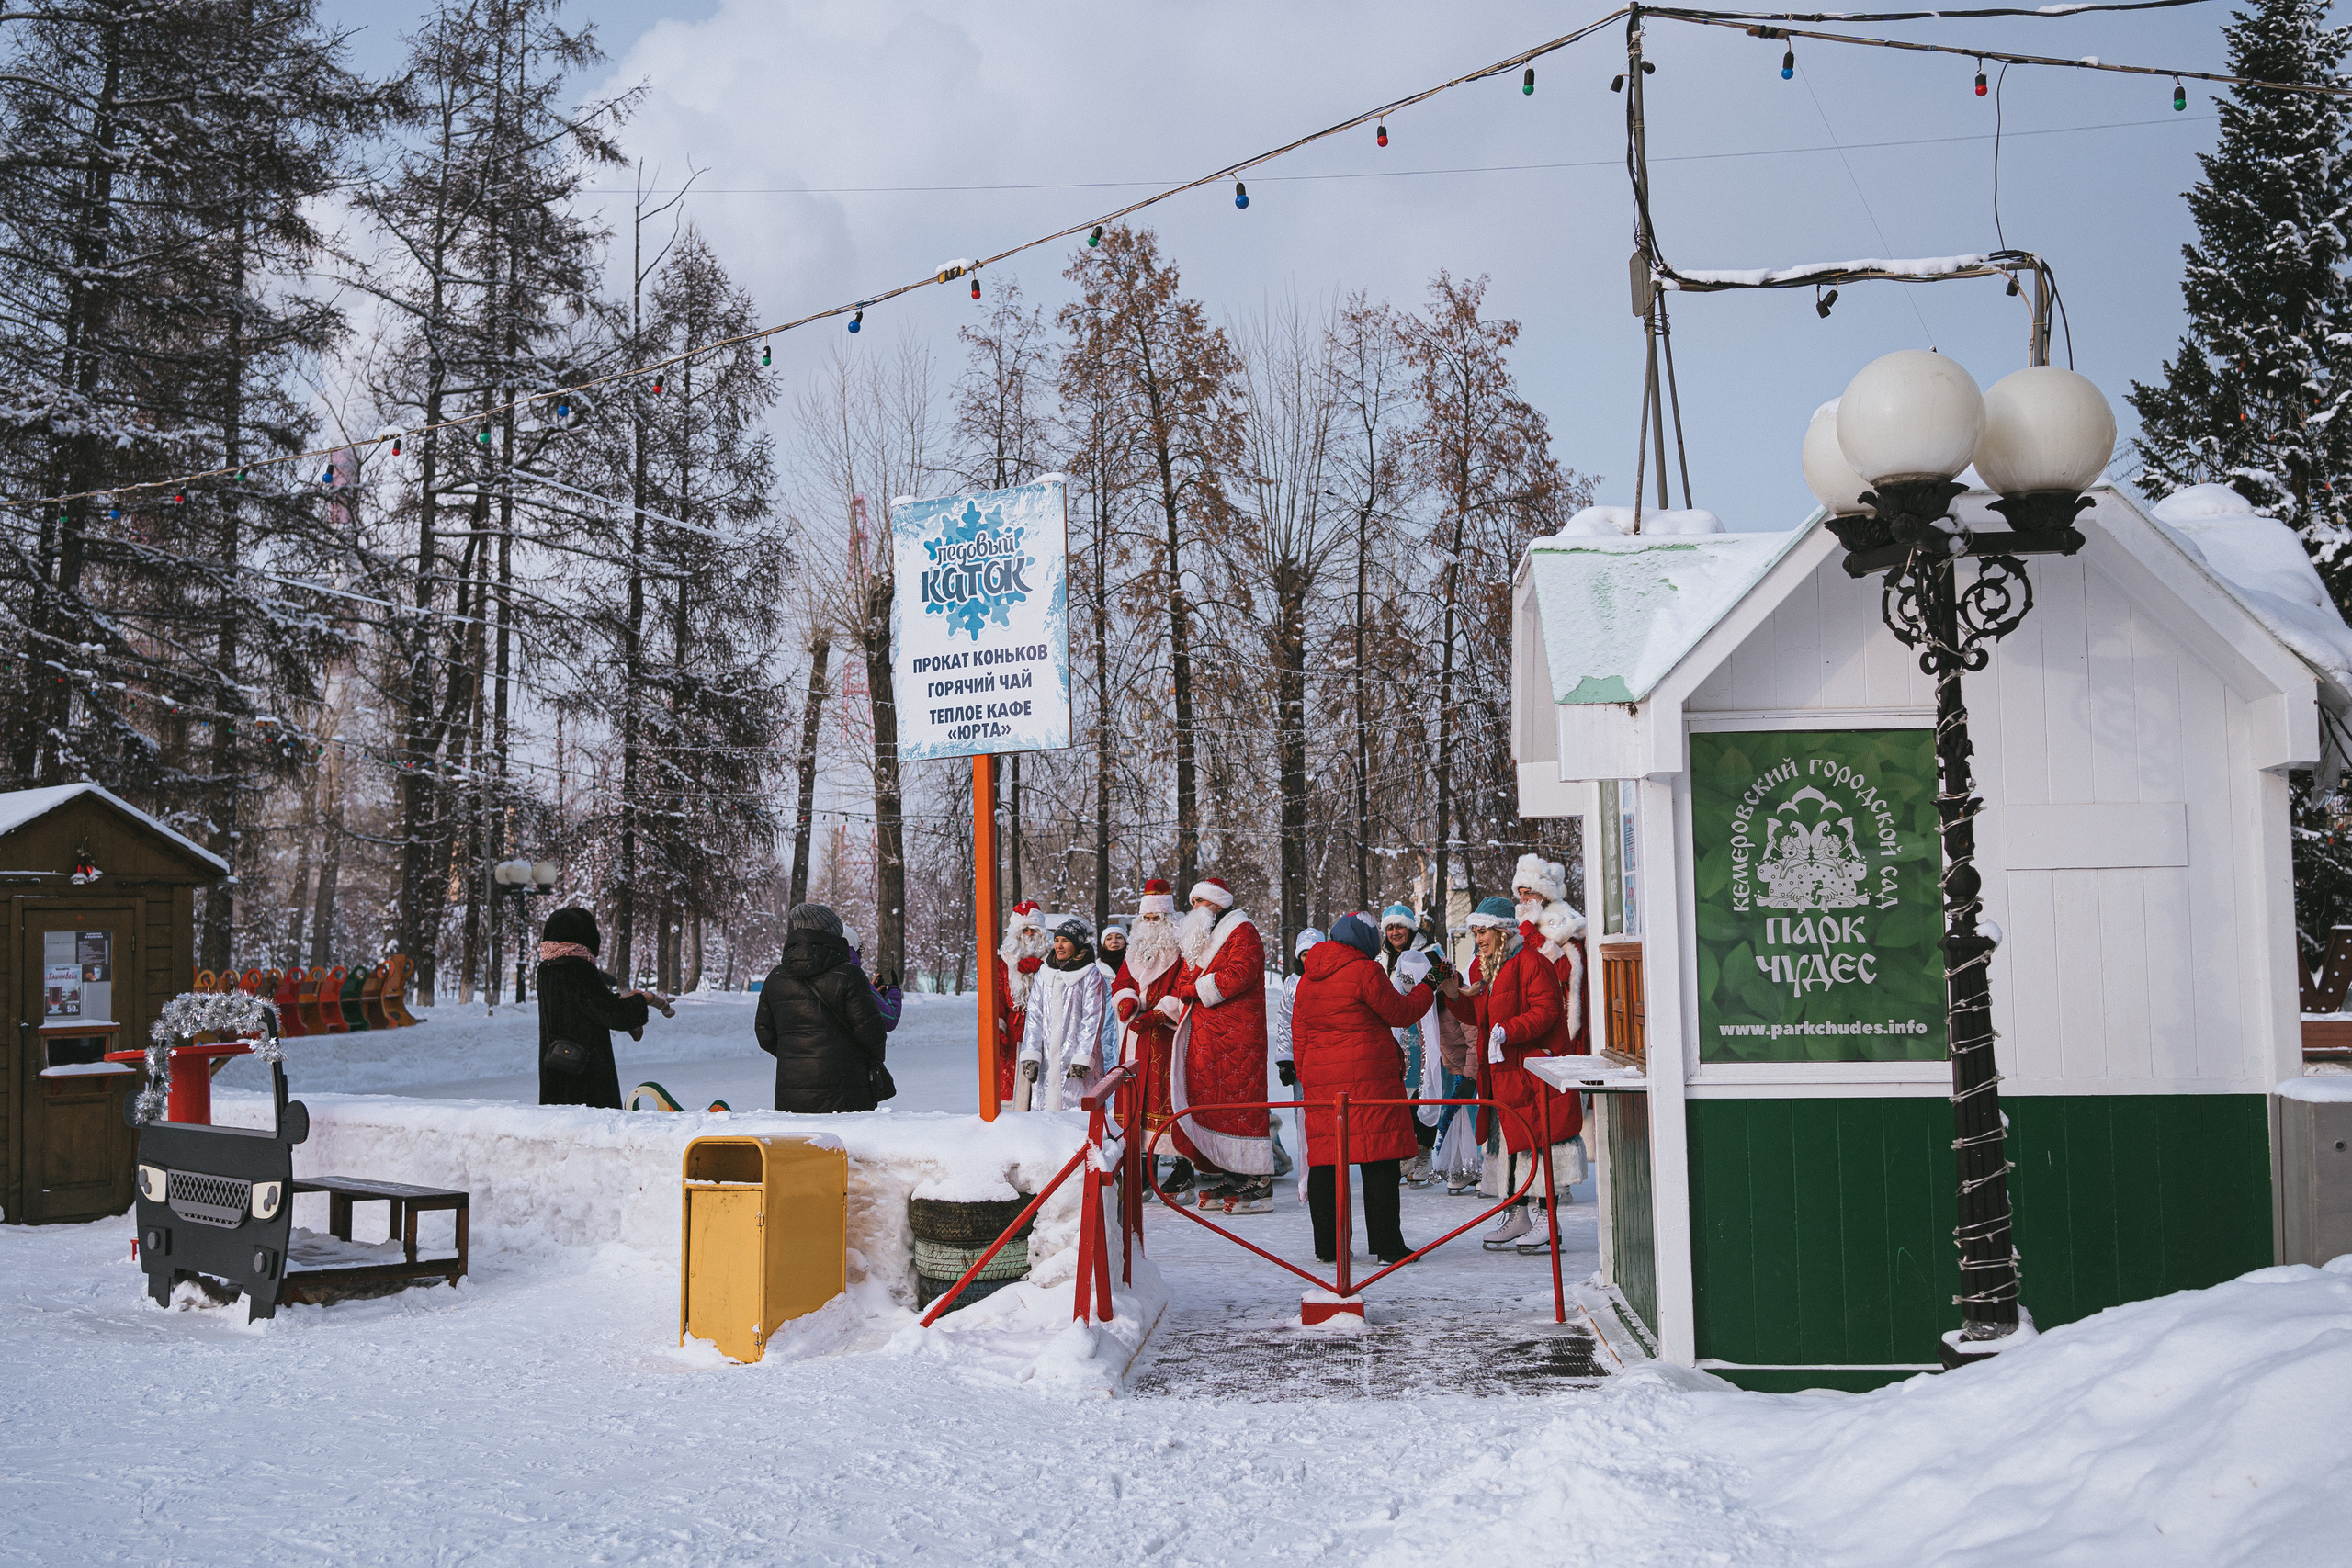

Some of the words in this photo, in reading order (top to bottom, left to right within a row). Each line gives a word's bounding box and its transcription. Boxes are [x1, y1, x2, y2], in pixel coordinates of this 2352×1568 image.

[913, 652, 969, 673] ПРОКАТ
[973, 644, 1048, 666] КОНЬКОВ
[927, 672, 995, 698] ГОРЯЧИЙ
[999, 669, 1033, 690] ЧАЙ
[929, 705, 983, 725] ТЕПЛОЕ
[987, 700, 1033, 720] КАФЕ
[947, 722, 1012, 741] «ЮРТА»
[1756, 953, 1878, 998] ЧУДЕС
[1718, 1019, 1928, 1040] www.parkchudes.info
